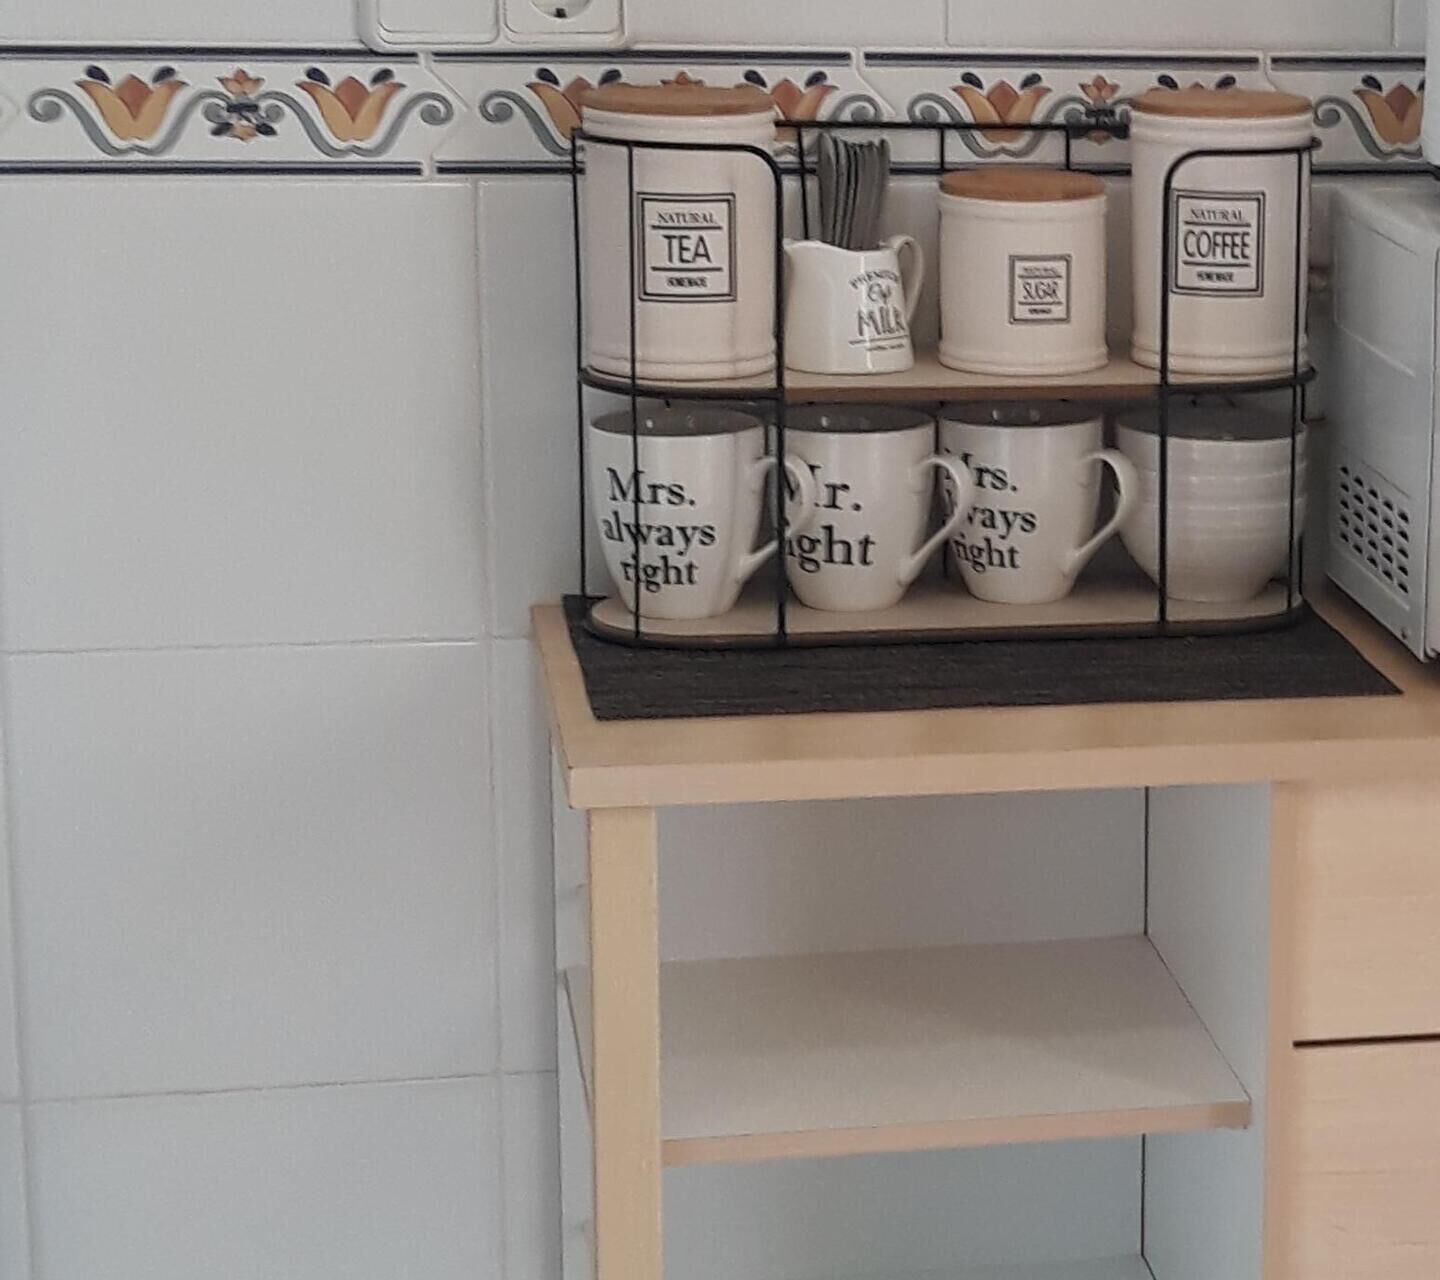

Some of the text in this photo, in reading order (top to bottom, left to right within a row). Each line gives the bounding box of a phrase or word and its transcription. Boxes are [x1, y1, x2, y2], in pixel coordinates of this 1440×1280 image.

[661, 234, 712, 263] TEA
[1183, 229, 1251, 260] COFFEE
[606, 466, 696, 506] Mrs.
[601, 509, 716, 557] always
